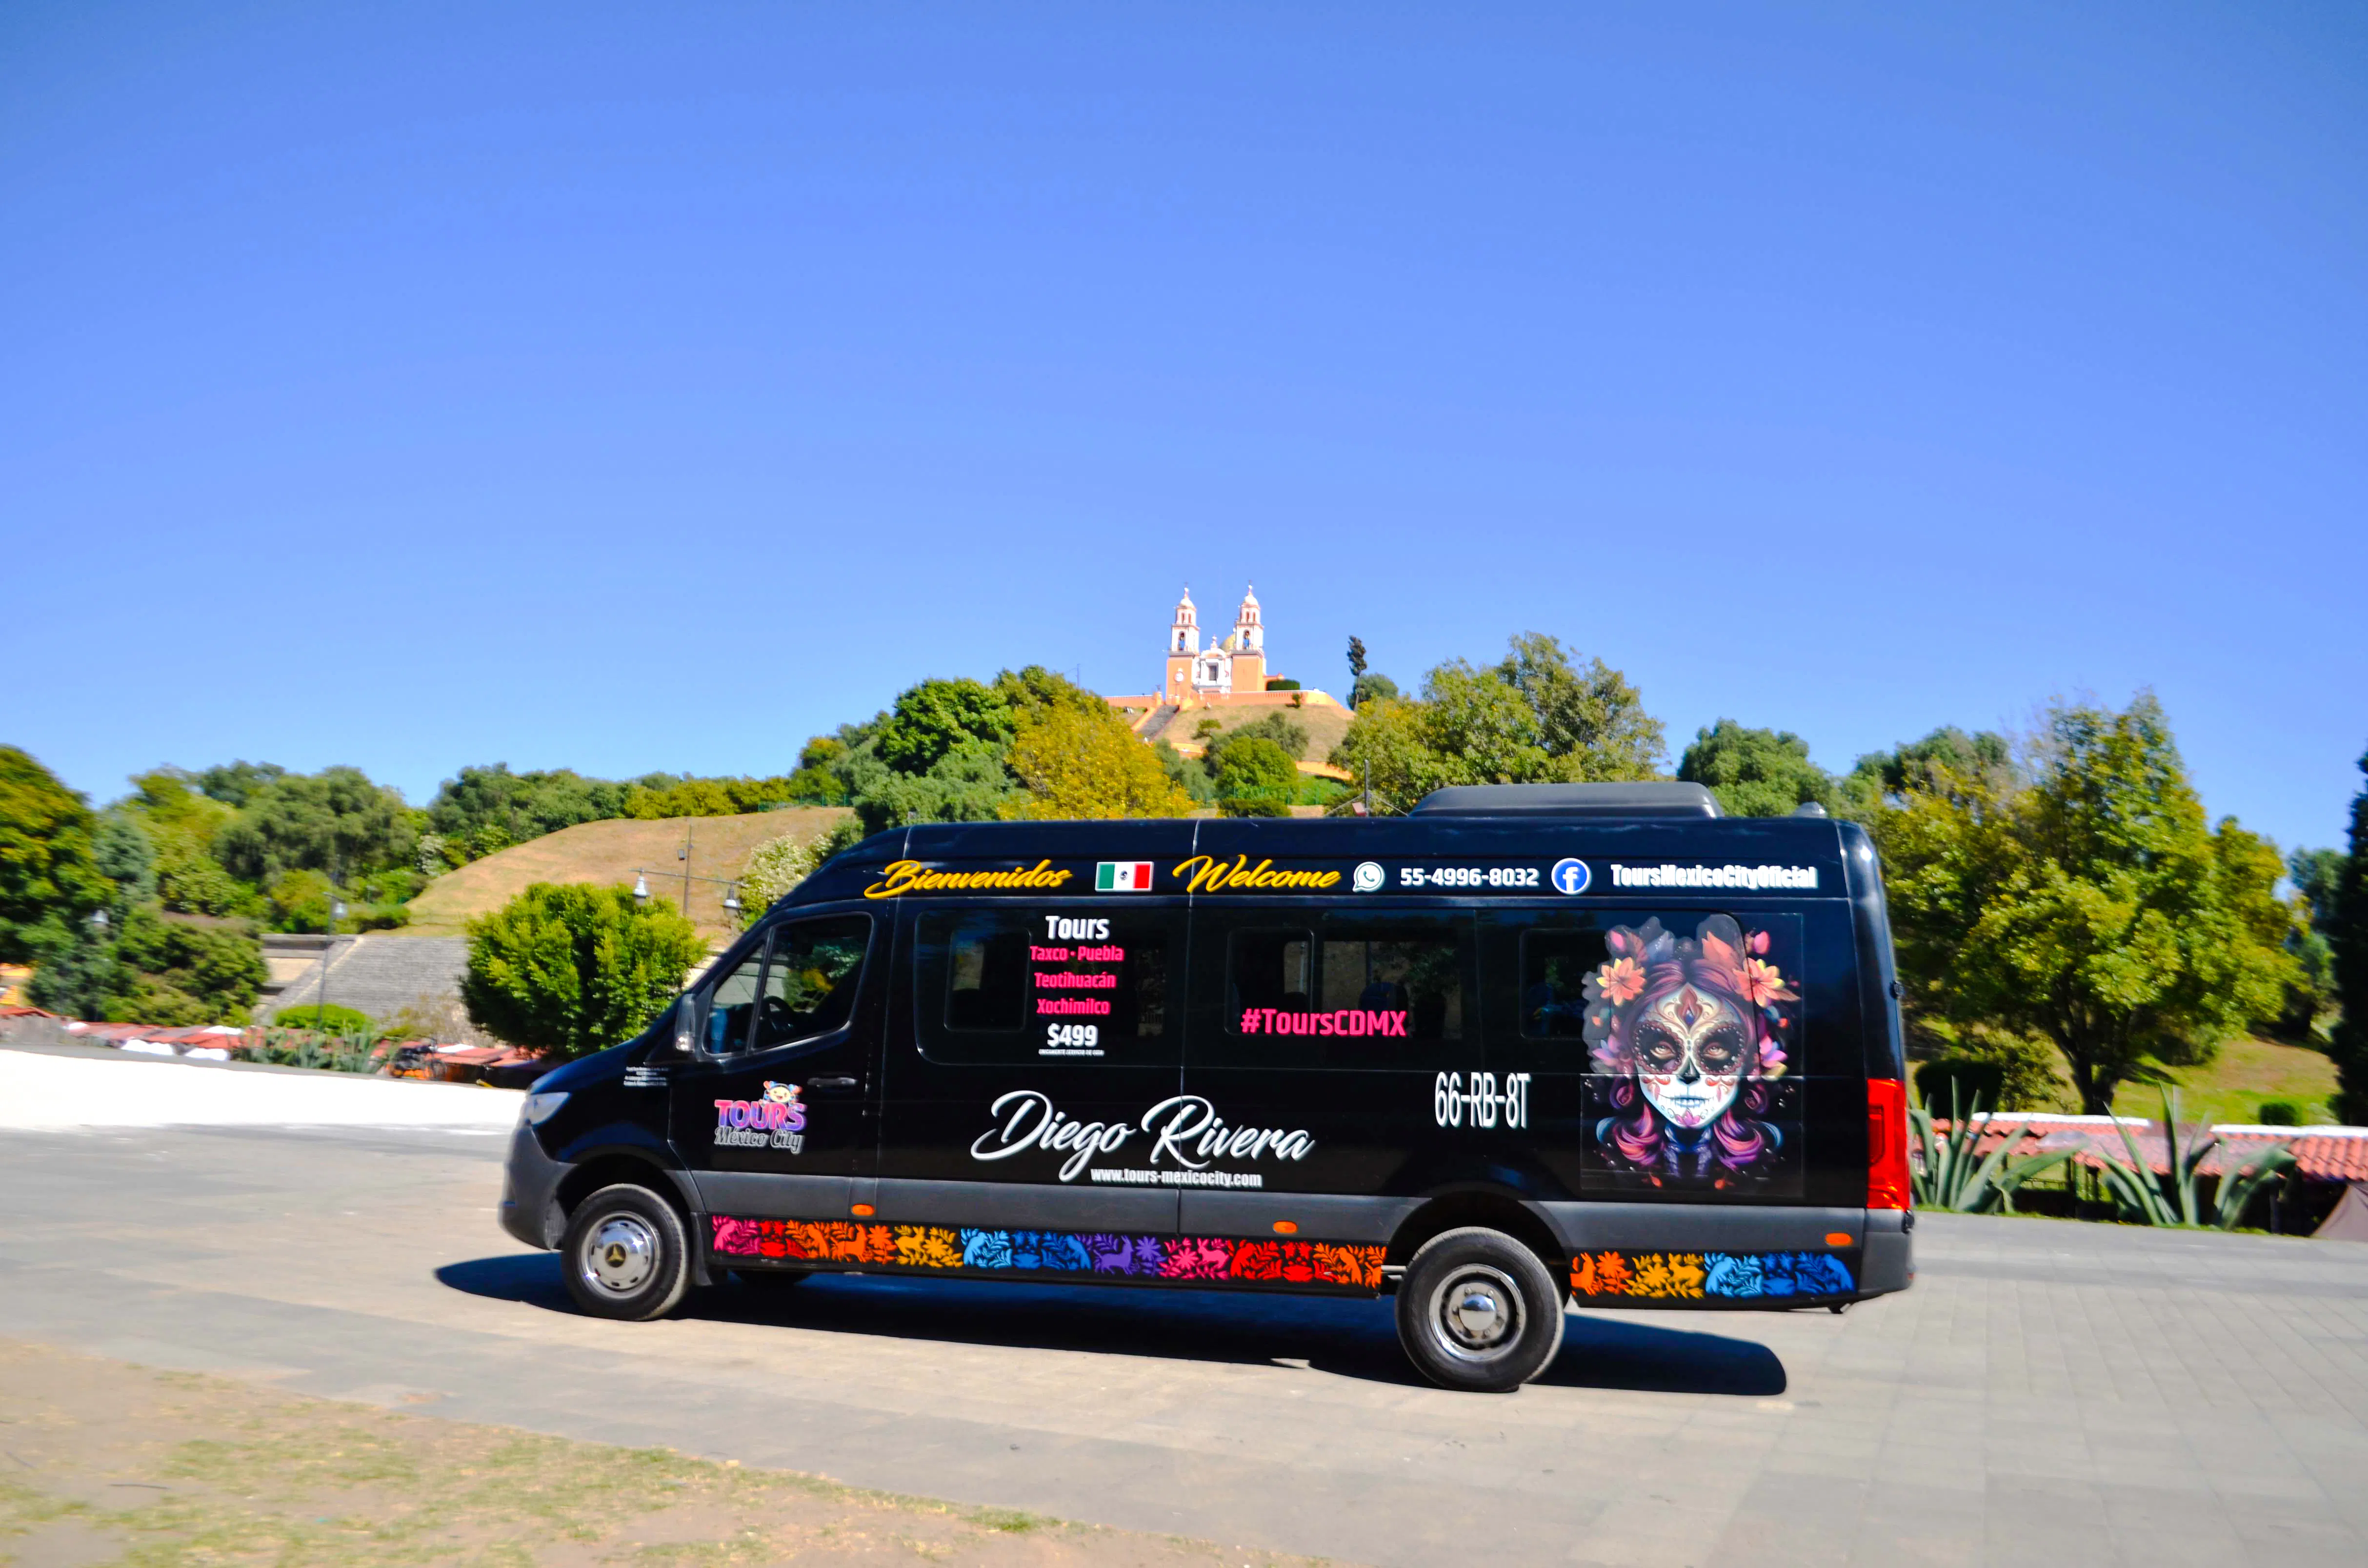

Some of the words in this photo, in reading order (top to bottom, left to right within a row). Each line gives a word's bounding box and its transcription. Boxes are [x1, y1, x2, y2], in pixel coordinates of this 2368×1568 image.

[864, 859, 1073, 899] Bienvenidos
[1172, 854, 1341, 893] Welcome
[1400, 868, 1539, 887] 55-4996-8032
[1610, 864, 1818, 890] ToursMexicoCityOficial
[1045, 915, 1109, 940] Tours
[1030, 946, 1068, 961] Taxco
[1077, 945, 1124, 961] Puebla
[1034, 972, 1116, 989] Teotihuacán
[1036, 998, 1111, 1015] Xochimilco
[1047, 1023, 1098, 1047] $499
[1241, 1008, 1407, 1037] #ToursCDMX
[1435, 1072, 1530, 1129] 66-RB-8T
[714, 1099, 807, 1131] TOURS
[714, 1125, 768, 1147] México
[770, 1128, 804, 1154] City
[971, 1090, 1137, 1182] Diego
[1141, 1095, 1316, 1170] Rivera
[1090, 1169, 1263, 1188] www.tours-mexicocity.com
